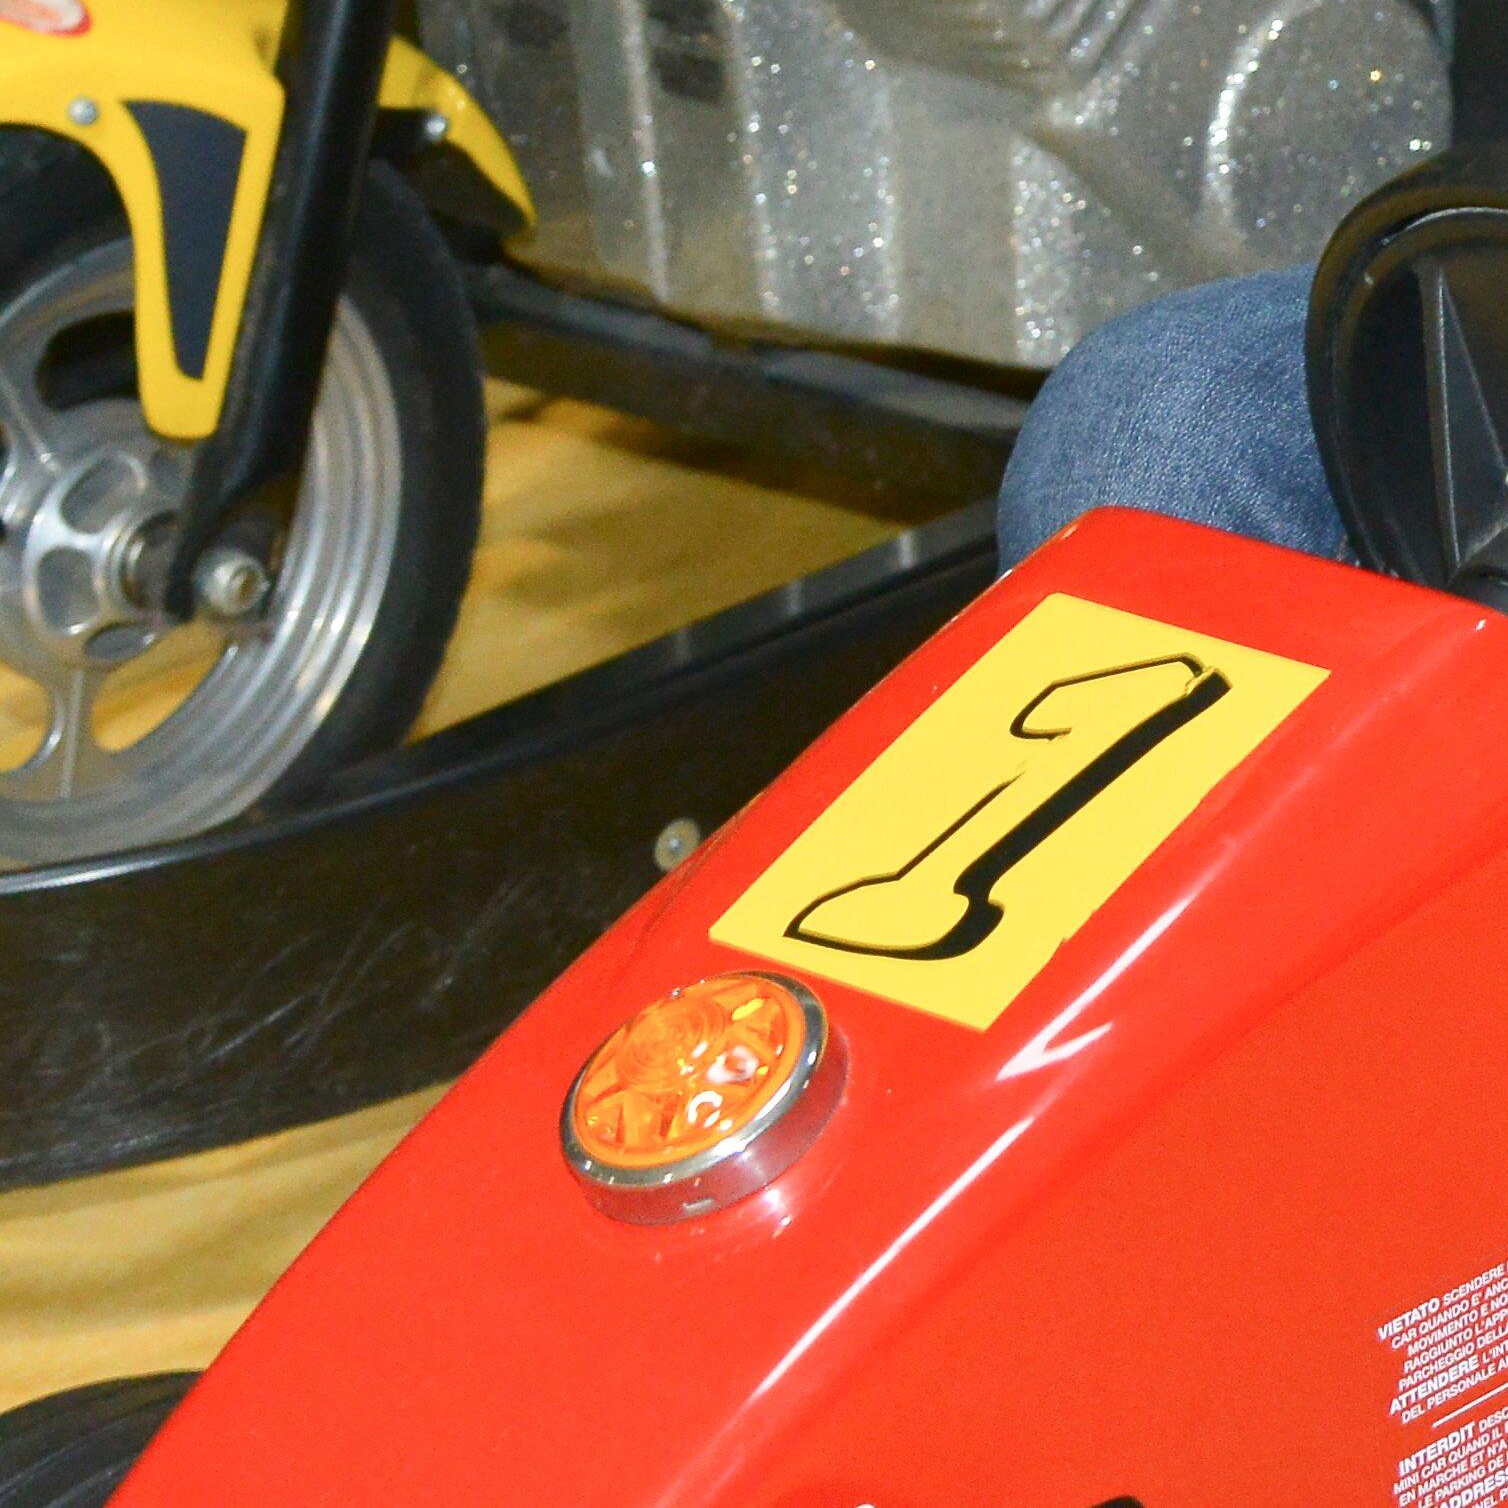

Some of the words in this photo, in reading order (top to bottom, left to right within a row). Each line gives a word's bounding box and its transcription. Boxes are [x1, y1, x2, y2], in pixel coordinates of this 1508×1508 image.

[1377, 1297, 1440, 1341] VIETATO
[1443, 1264, 1505, 1306] SCENDERE
[1391, 1327, 1418, 1350] CAR
[1418, 1300, 1470, 1334] QUANDO
[1403, 1327, 1473, 1373] RAGGIUNTO
[1407, 1309, 1479, 1356] MOVIMENTO
[1388, 1354, 1480, 1416] ATTENDERE
[1398, 1342, 1475, 1392] PARCHEGGIO
[1401, 1403, 1426, 1425] DEL
[1426, 1362, 1497, 1411] PERSONALE
[1392, 1471, 1420, 1496] MINI
[1421, 1456, 1447, 1480] CAR
[1448, 1433, 1491, 1465] QUAND
[1491, 1428, 1504, 1441] IL
[1397, 1421, 1476, 1477] INTERDIT
[1398, 1489, 1417, 1508] EN
[1417, 1461, 1469, 1496] MARCHE
[1470, 1450, 1486, 1466] ET
[1417, 1492, 1434, 1508] LE
[1434, 1467, 1486, 1501] PARKING
[1487, 1455, 1505, 1472] DE
